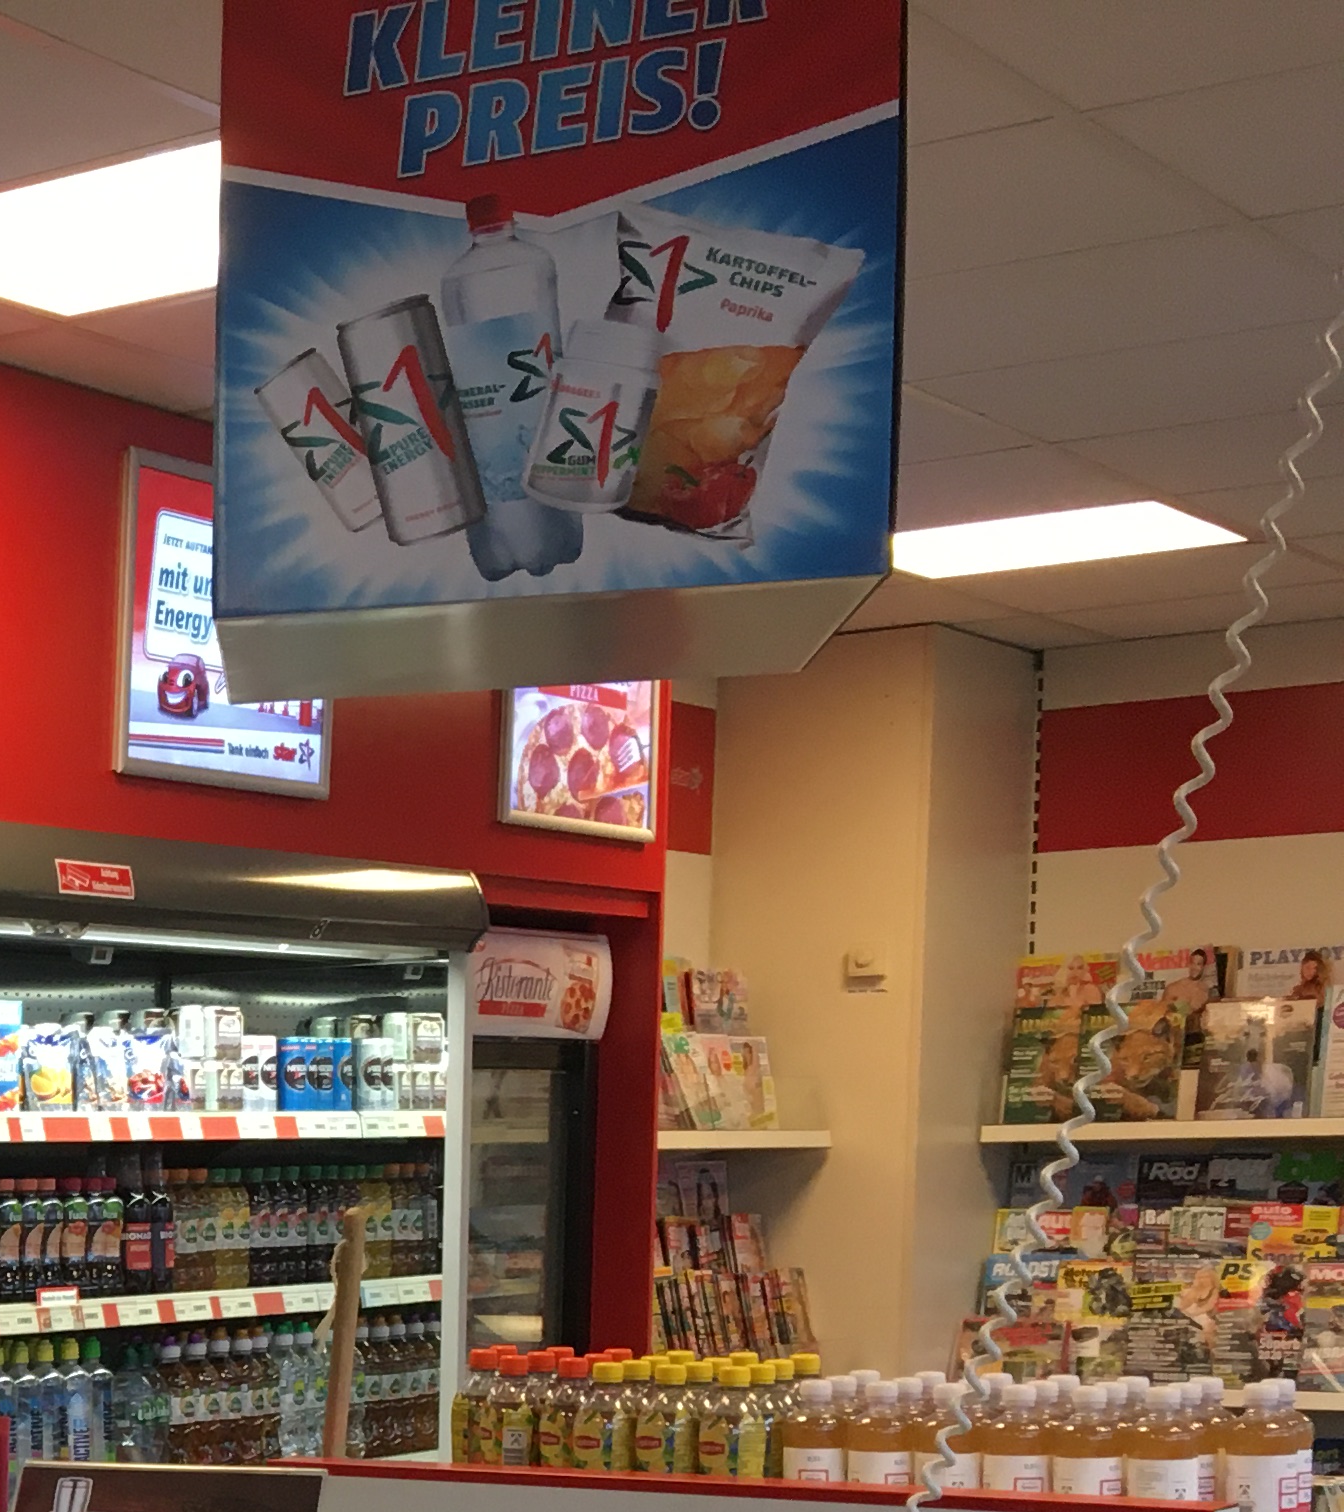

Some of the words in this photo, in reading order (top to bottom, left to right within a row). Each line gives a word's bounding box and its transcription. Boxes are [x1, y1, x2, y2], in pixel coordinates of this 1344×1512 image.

[397, 38, 727, 178] PREIS!
[705, 246, 817, 290] KARTOFFEL-
[729, 272, 785, 298] CHIPS
[720, 298, 774, 322] Paprika
[390, 427, 428, 459] PURE
[567, 455, 596, 466] GUM
[158, 563, 189, 592] mit
[155, 600, 212, 643] Energy
[273, 743, 297, 761] star
